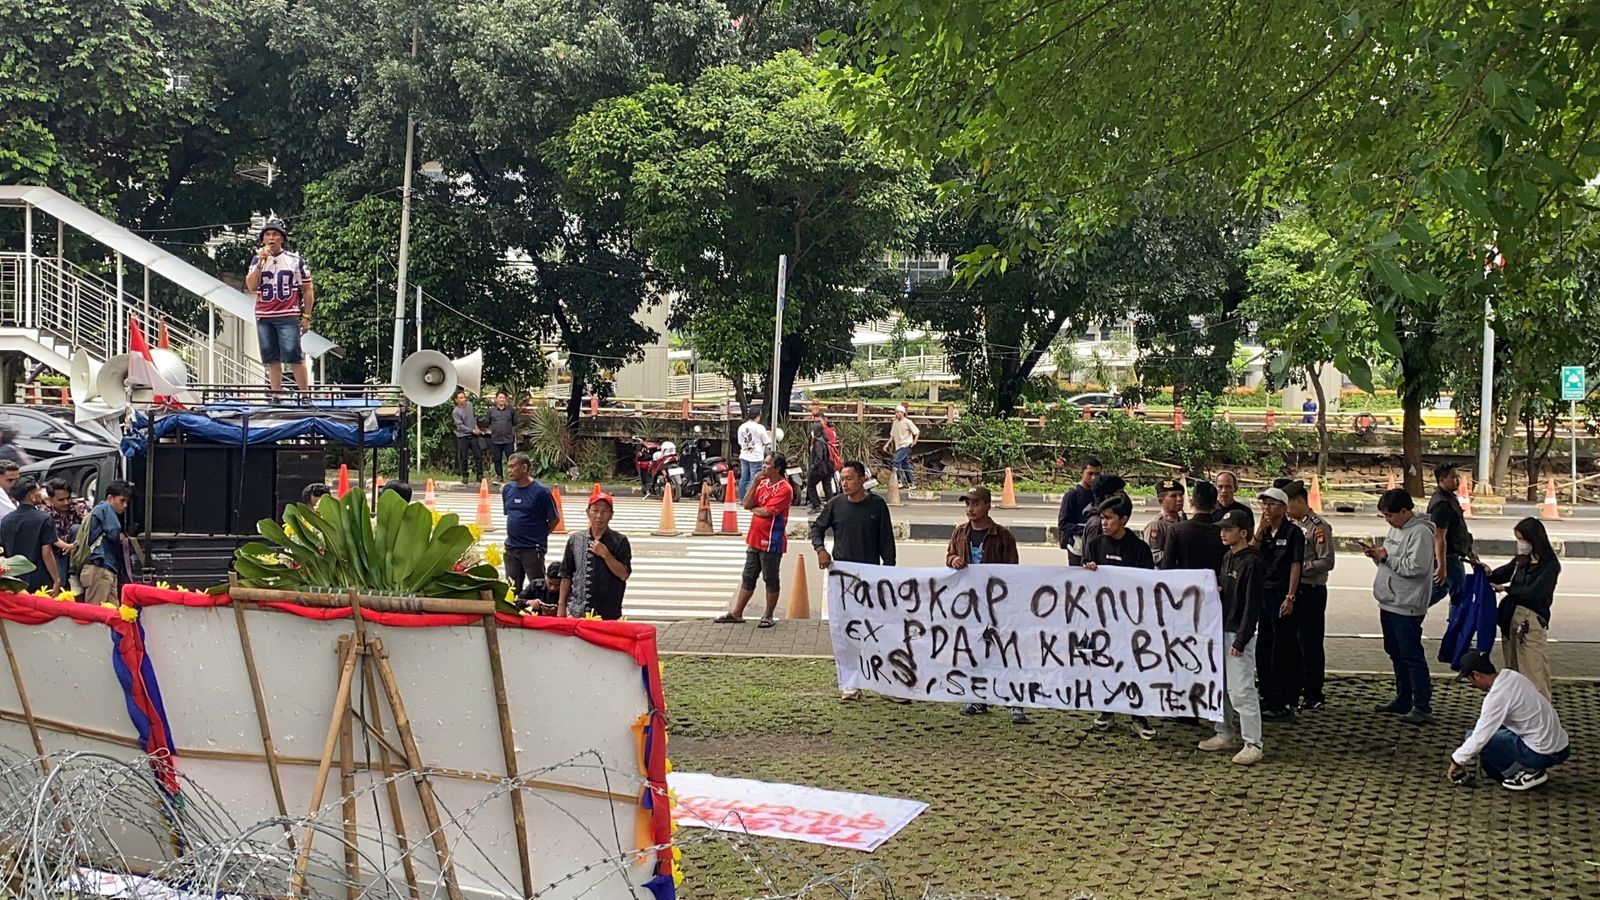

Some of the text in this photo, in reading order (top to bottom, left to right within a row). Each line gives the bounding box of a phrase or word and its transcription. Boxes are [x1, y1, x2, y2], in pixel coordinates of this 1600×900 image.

[260, 269, 295, 302] 60
[845, 619, 884, 643] EX
[903, 618, 1022, 670] PDAM
[1131, 628, 1218, 674] BKSI
